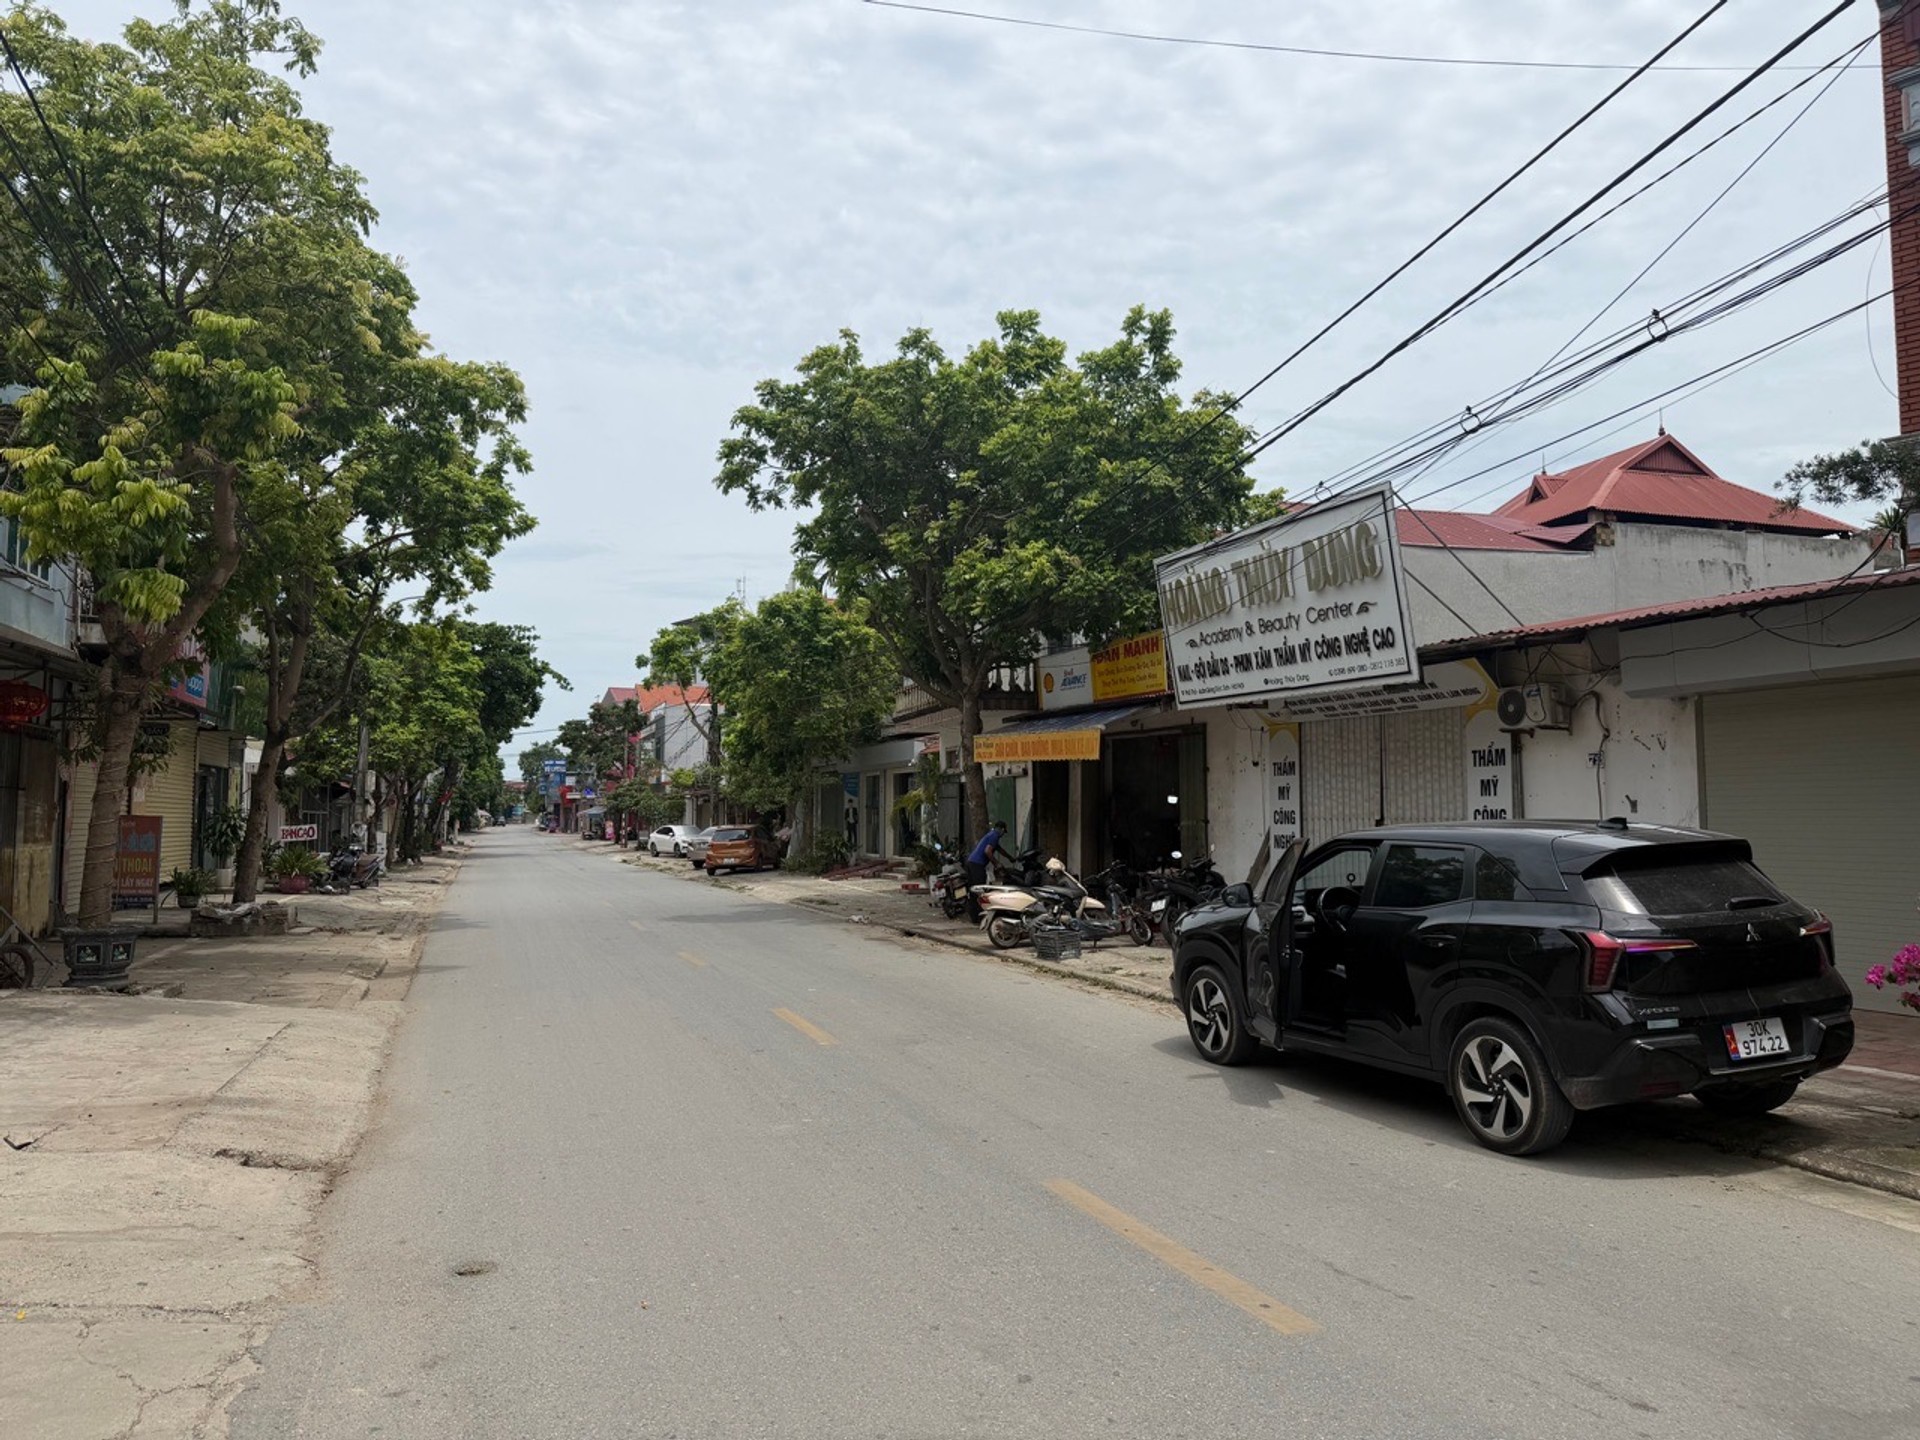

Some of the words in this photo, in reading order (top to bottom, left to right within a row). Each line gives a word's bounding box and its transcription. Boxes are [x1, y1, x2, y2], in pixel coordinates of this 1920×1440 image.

[1302, 520, 1383, 592] DUNG
[1199, 626, 1243, 646] Academy
[1245, 620, 1255, 636] &
[1258, 612, 1300, 634] Beauty
[1305, 602, 1353, 624] Center
[1233, 653, 1254, 673] PHUN
[1298, 638, 1312, 662] MỸ
[1314, 633, 1341, 660] CÔNG
[1343, 626, 1371, 658] NGHỆ
[1372, 626, 1395, 650] CAO
[1472, 741, 1506, 767] THẨM
[1272, 755, 1296, 776] THẨM
[1278, 783, 1291, 800] MỸ
[1480, 774, 1499, 796] MỸ
[1273, 807, 1296, 825] CÔNG
[122, 857, 153, 876] THOẠI
[1747, 1020, 1771, 1038] 30K
[1742, 1035, 1785, 1056] 974.22
